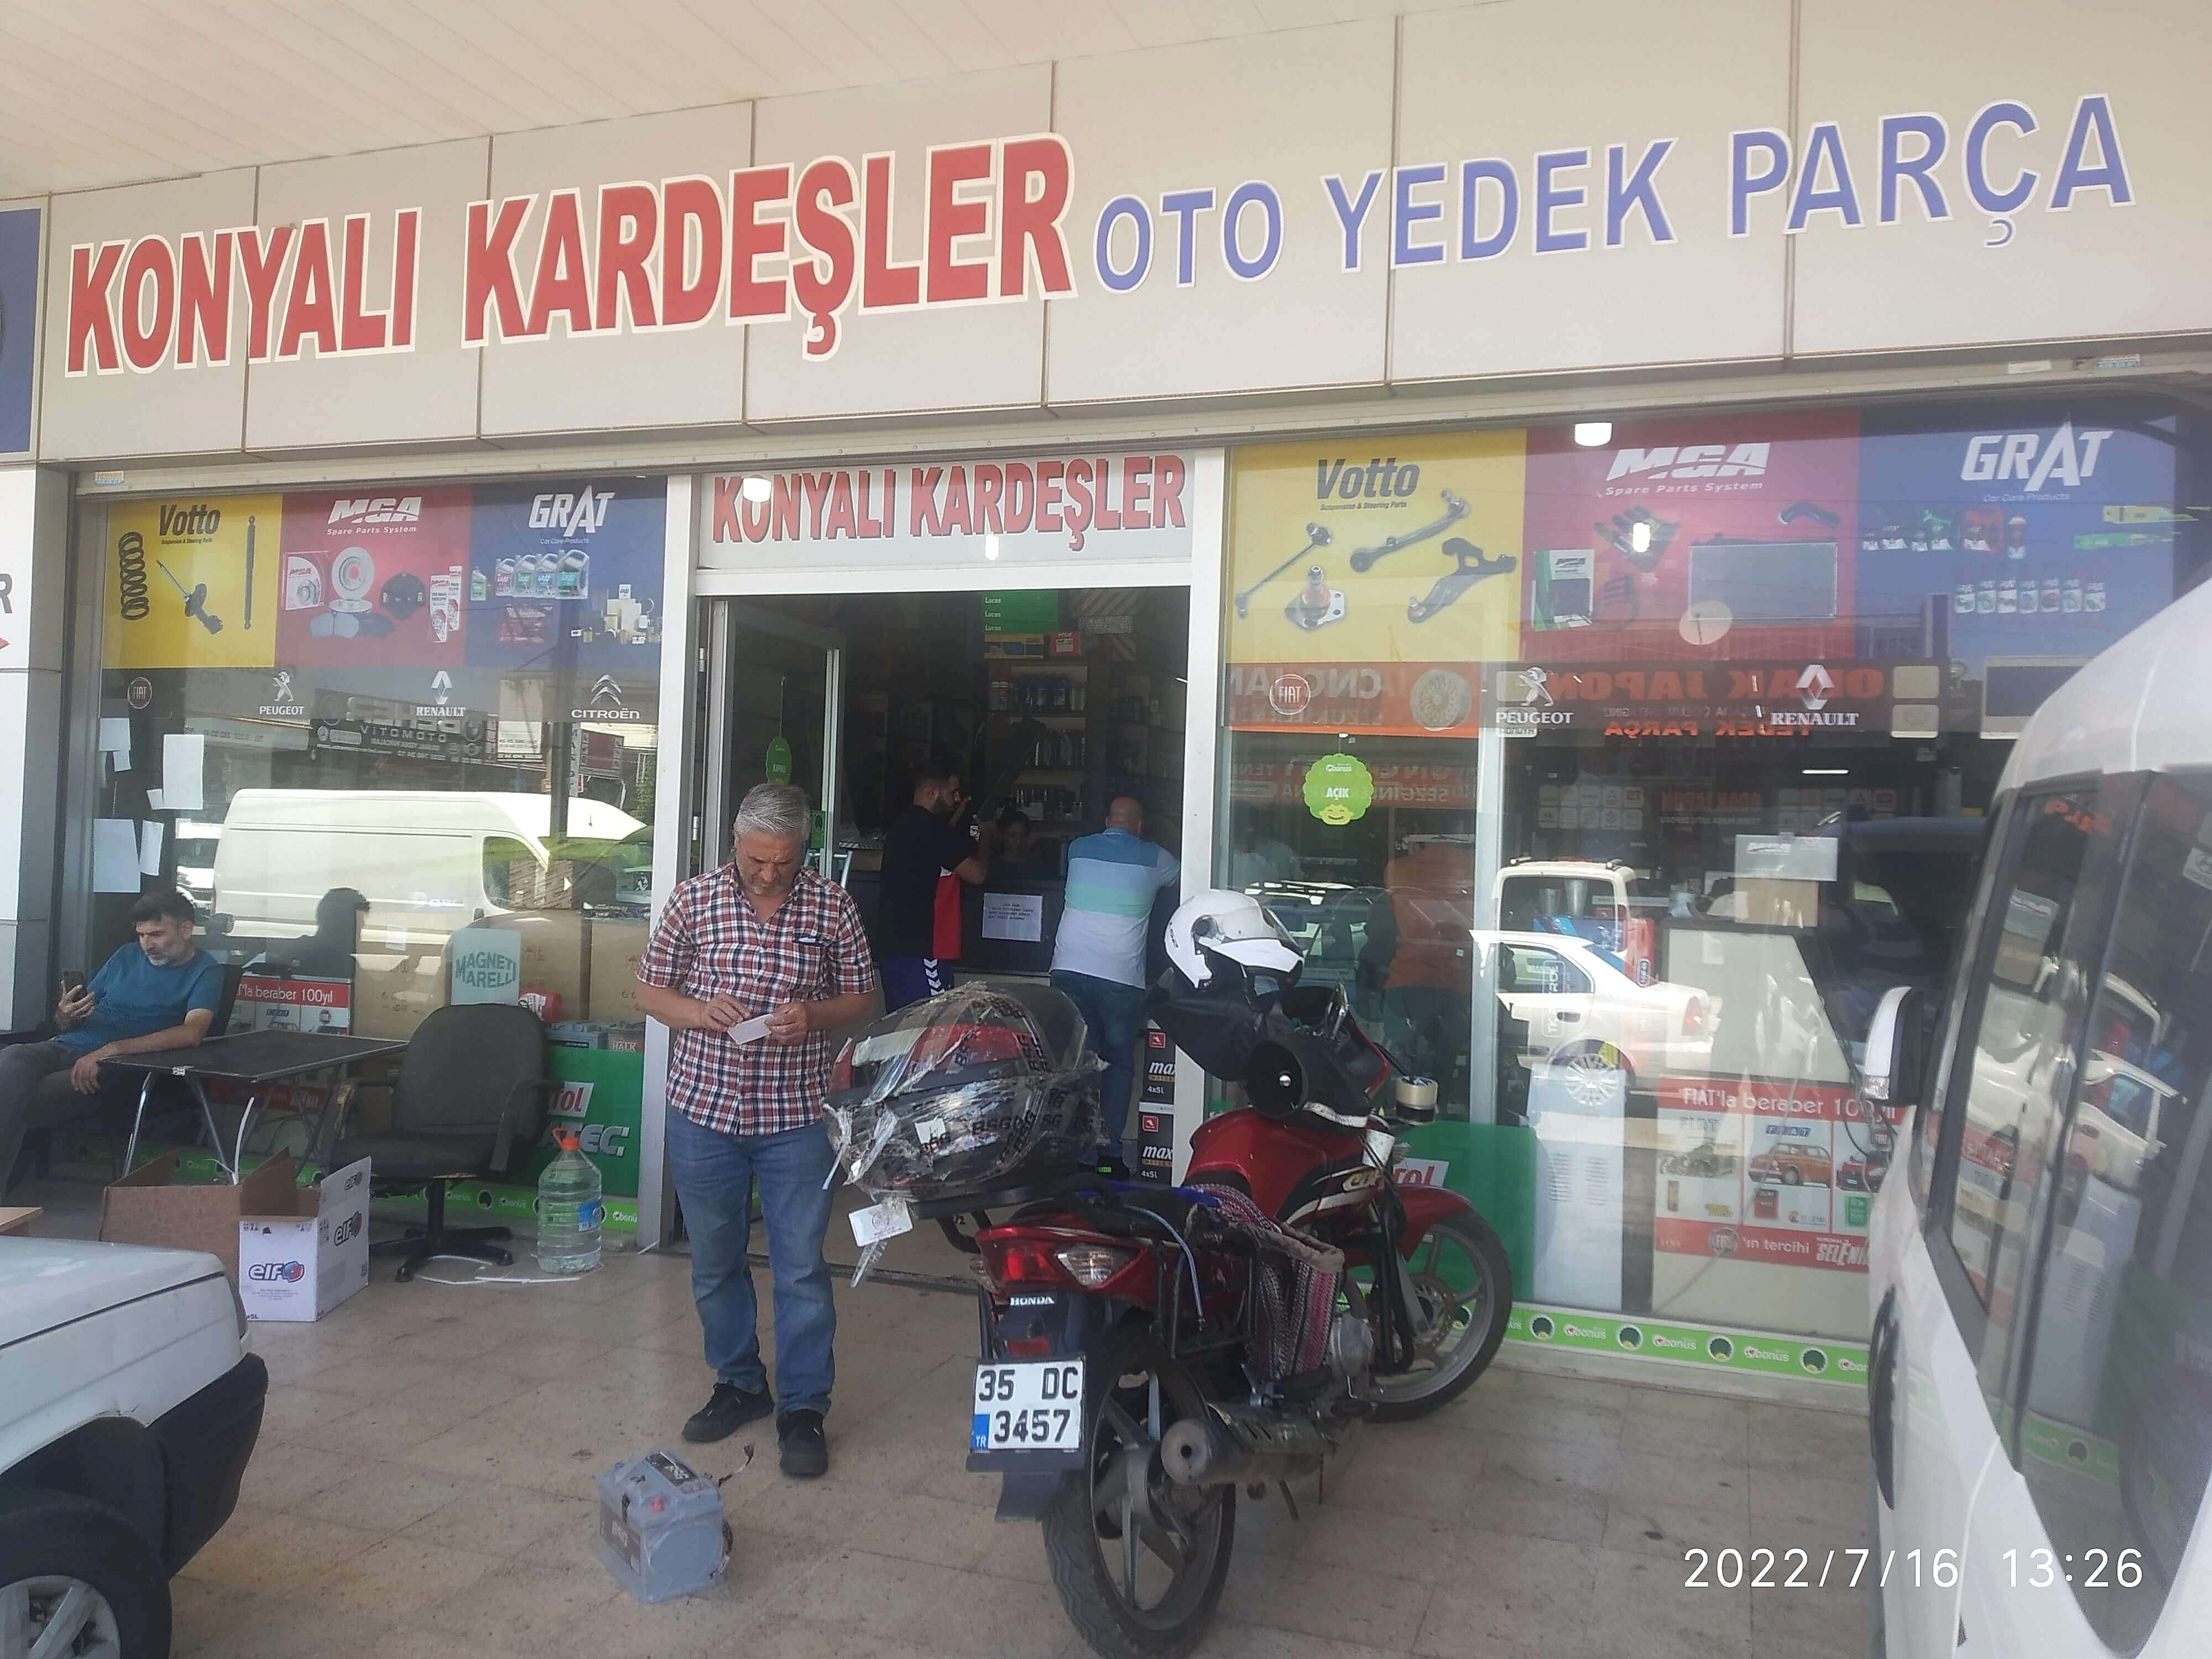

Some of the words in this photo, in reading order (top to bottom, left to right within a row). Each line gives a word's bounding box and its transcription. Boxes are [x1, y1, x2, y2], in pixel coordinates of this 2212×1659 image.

[65, 206, 422, 378] KONYALI
[461, 132, 1078, 362] KARDEŞLER
[1093, 180, 1285, 294] OTO
[1320, 137, 1678, 274] YEDEK
[1728, 92, 2136, 249] PARÇA
[1606, 442, 1771, 481] MGA
[1961, 412, 2115, 492] GRAT
[1316, 457, 1420, 499] Votto
[1605, 485, 1650, 496] Spare
[1656, 483, 1699, 493] Parts
[1705, 481, 1763, 491] System
[327, 496, 422, 524] MGA
[529, 484, 615, 537] GRAT
[712, 469, 896, 544] KONYALI
[910, 455, 1186, 551] KARDEŞLER
[1390, 500, 1407, 508] Parts
[159, 504, 221, 536] Votto
[327, 528, 352, 536] Spare
[384, 525, 417, 534] System
[133, 686, 147, 698] FIAT
[1279, 686, 1302, 704] FIAT
[260, 706, 304, 715] PEUGEOT
[416, 707, 466, 717] RENAULT
[1495, 712, 1574, 724] PEUGEOT
[1770, 712, 1859, 726] RENAULT
[1326, 786, 1349, 801] AÇIK
[456, 952, 517, 972] MAGNETI
[456, 968, 517, 988] MARELLI
[256, 985, 297, 1000] beraber
[1682, 1087, 1736, 1108] FIAT'la
[1743, 1092, 1824, 1114] beraber
[1764, 1240, 1810, 1254] tercihi
[249, 1262, 284, 1281] elf
[1010, 1296, 1055, 1306] HONDA
[978, 1369, 1015, 1401] 35
[1041, 1366, 1079, 1400] DC
[975, 1435, 987, 1447] TR
[993, 1409, 1071, 1444] 3457
